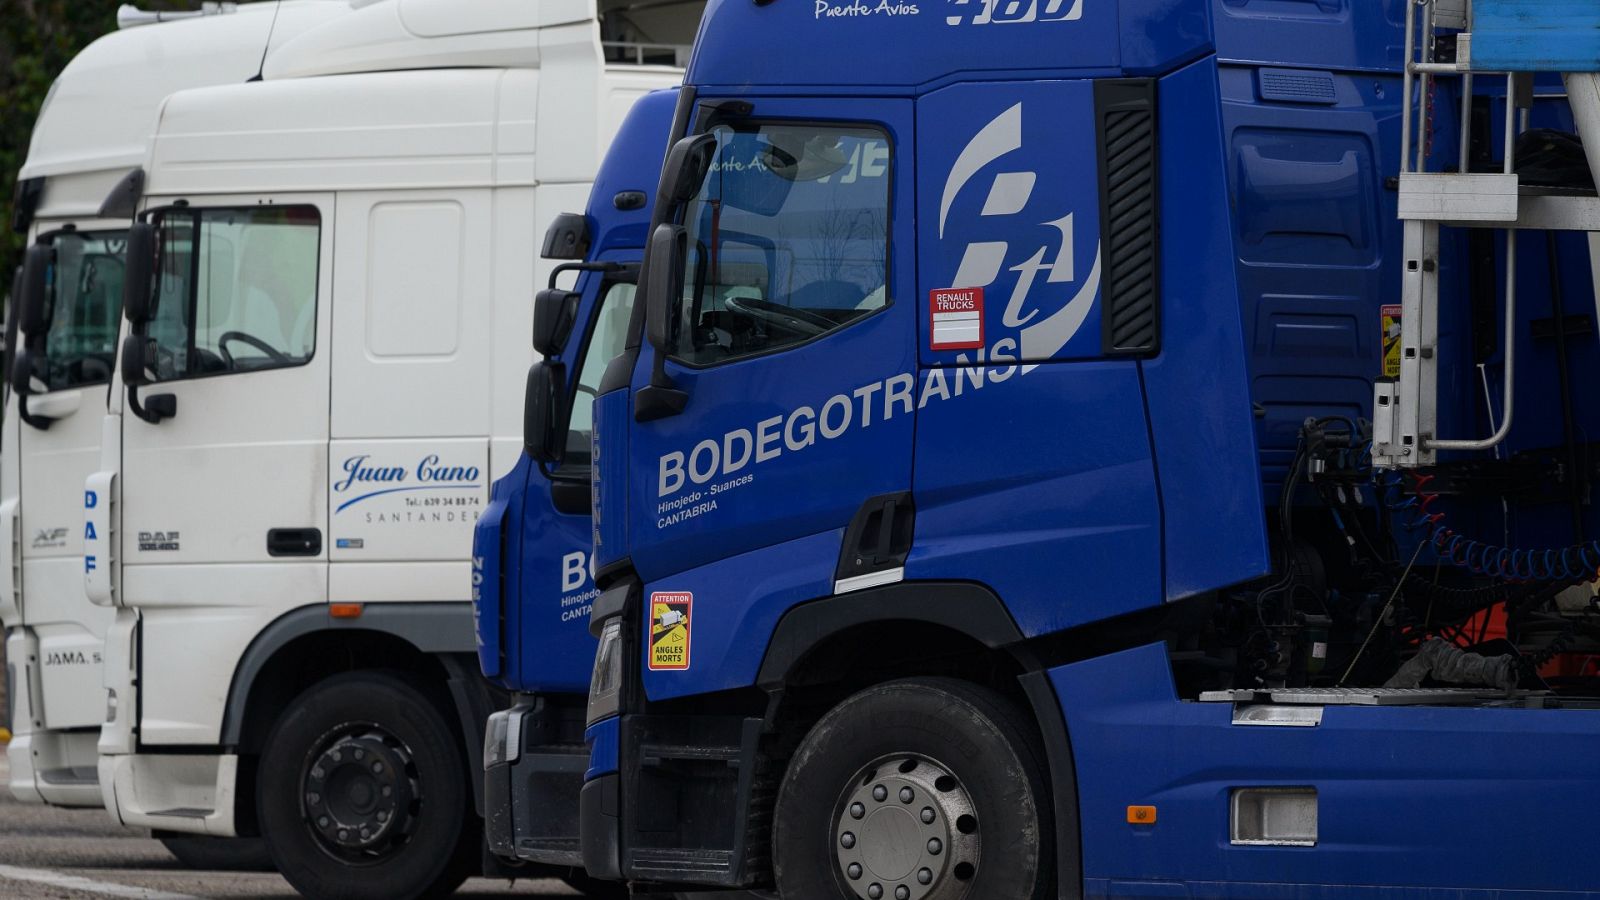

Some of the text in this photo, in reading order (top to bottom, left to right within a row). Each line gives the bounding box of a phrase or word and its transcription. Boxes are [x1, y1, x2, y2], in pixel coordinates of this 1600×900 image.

[815, 0, 920, 19] Puente Avios
[936, 292, 974, 303] RENAULT
[937, 301, 975, 311] TRUCKS
[658, 338, 1017, 499] BODEGOTRANS
[334, 454, 480, 492] Juan Cano
[658, 491, 701, 515] Hinojedo
[710, 473, 754, 496] Suances
[443, 498, 453, 507] 34
[468, 498, 480, 507] 74
[366, 511, 480, 524] SANTANDER
[657, 500, 718, 529] CANTABRIA
[138, 531, 180, 542] DAF
[654, 595, 689, 603] ATTENTION
[655, 646, 683, 655] ANGLES
[656, 654, 682, 663] MORTS
